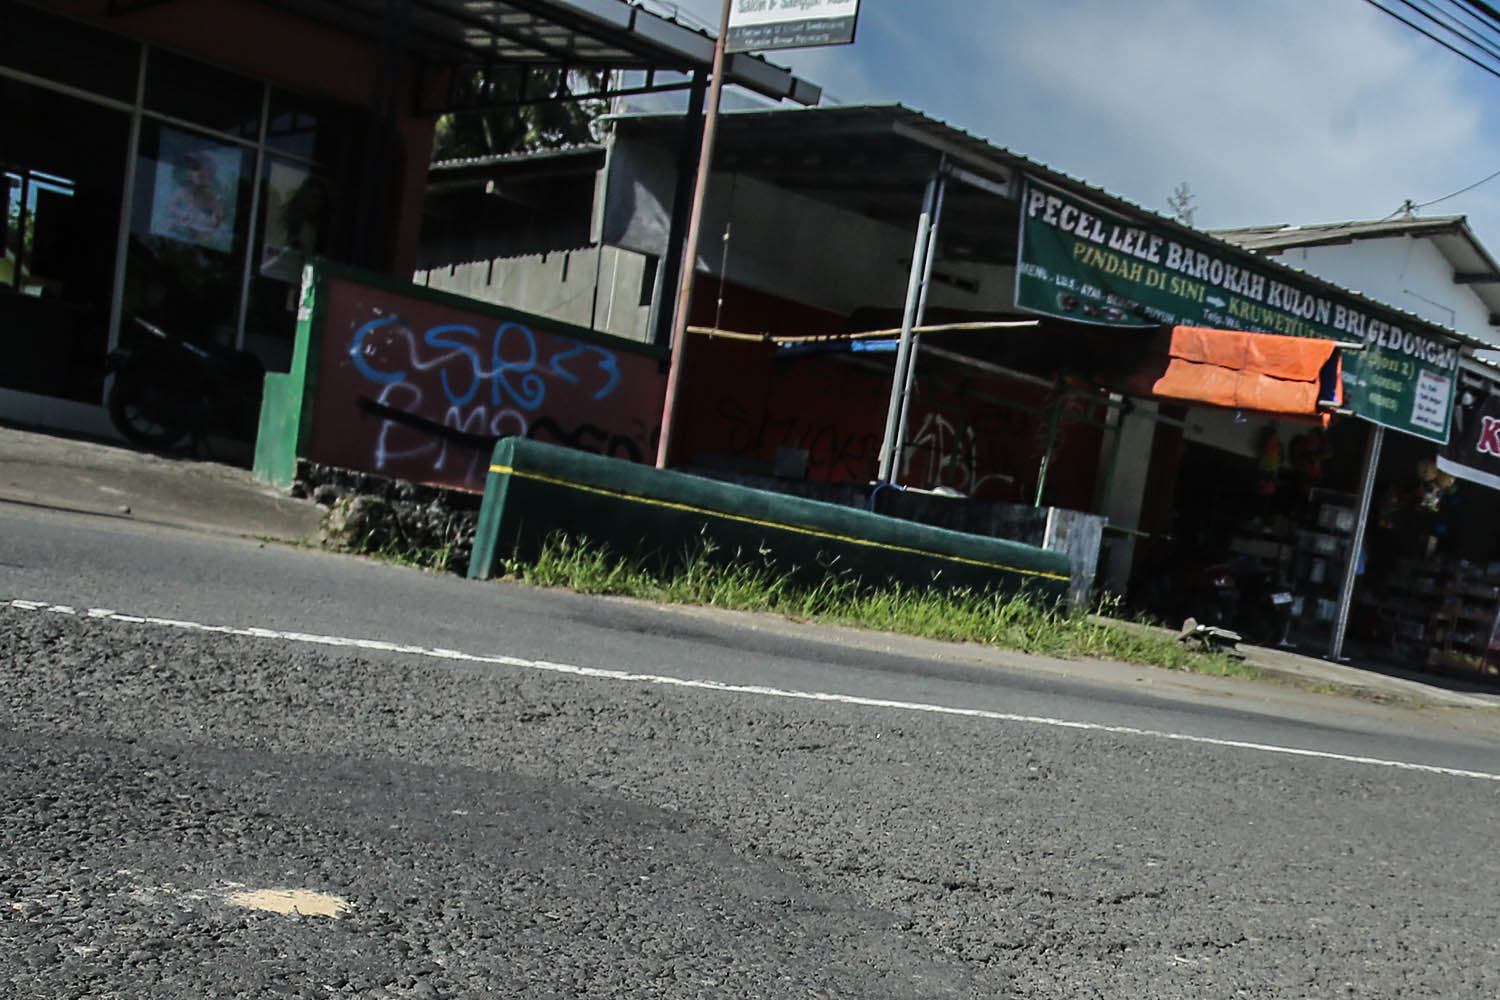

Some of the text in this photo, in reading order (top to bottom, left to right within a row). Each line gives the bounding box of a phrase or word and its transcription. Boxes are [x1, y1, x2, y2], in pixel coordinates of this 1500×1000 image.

[1028, 188, 1106, 244] PECEL
[1108, 226, 1162, 264] LELE
[1165, 241, 1265, 301] BAROKAH
[1267, 279, 1332, 326] KULON
[1334, 304, 1366, 338] BRI
[1073, 242, 1143, 283] PINDAH
[1144, 269, 1167, 291] DI
[1170, 280, 1207, 304] SINI
